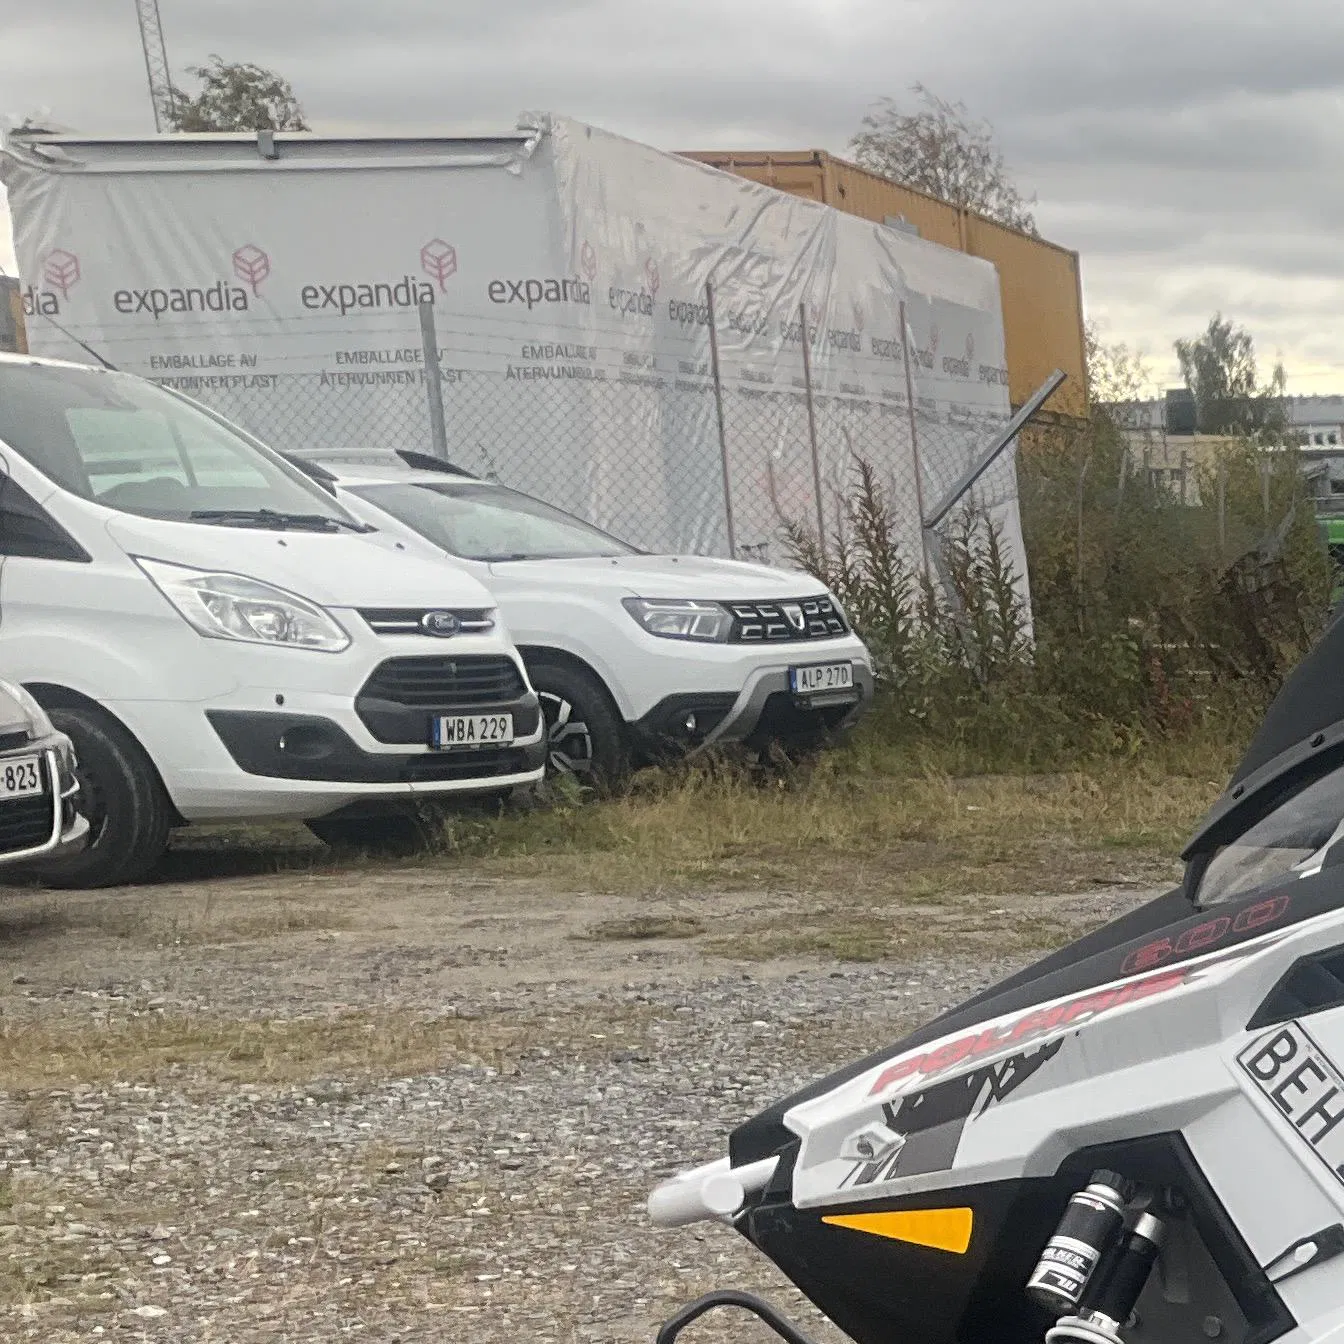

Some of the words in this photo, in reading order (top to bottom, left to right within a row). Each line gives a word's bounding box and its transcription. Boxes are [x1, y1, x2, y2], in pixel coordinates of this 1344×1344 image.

[113, 280, 249, 321] expandia
[300, 275, 435, 316] expandia
[150, 353, 236, 369] EMBALLAGE
[240, 353, 258, 367] AV
[335, 349, 422, 365] EMBALLAGE
[801, 668, 823, 689] ALP
[826, 666, 848, 687] 270
[445, 718, 475, 742] WBA
[479, 717, 508, 740] 229
[1120, 895, 1290, 975] 600
[868, 967, 1189, 1098] POLARIS
